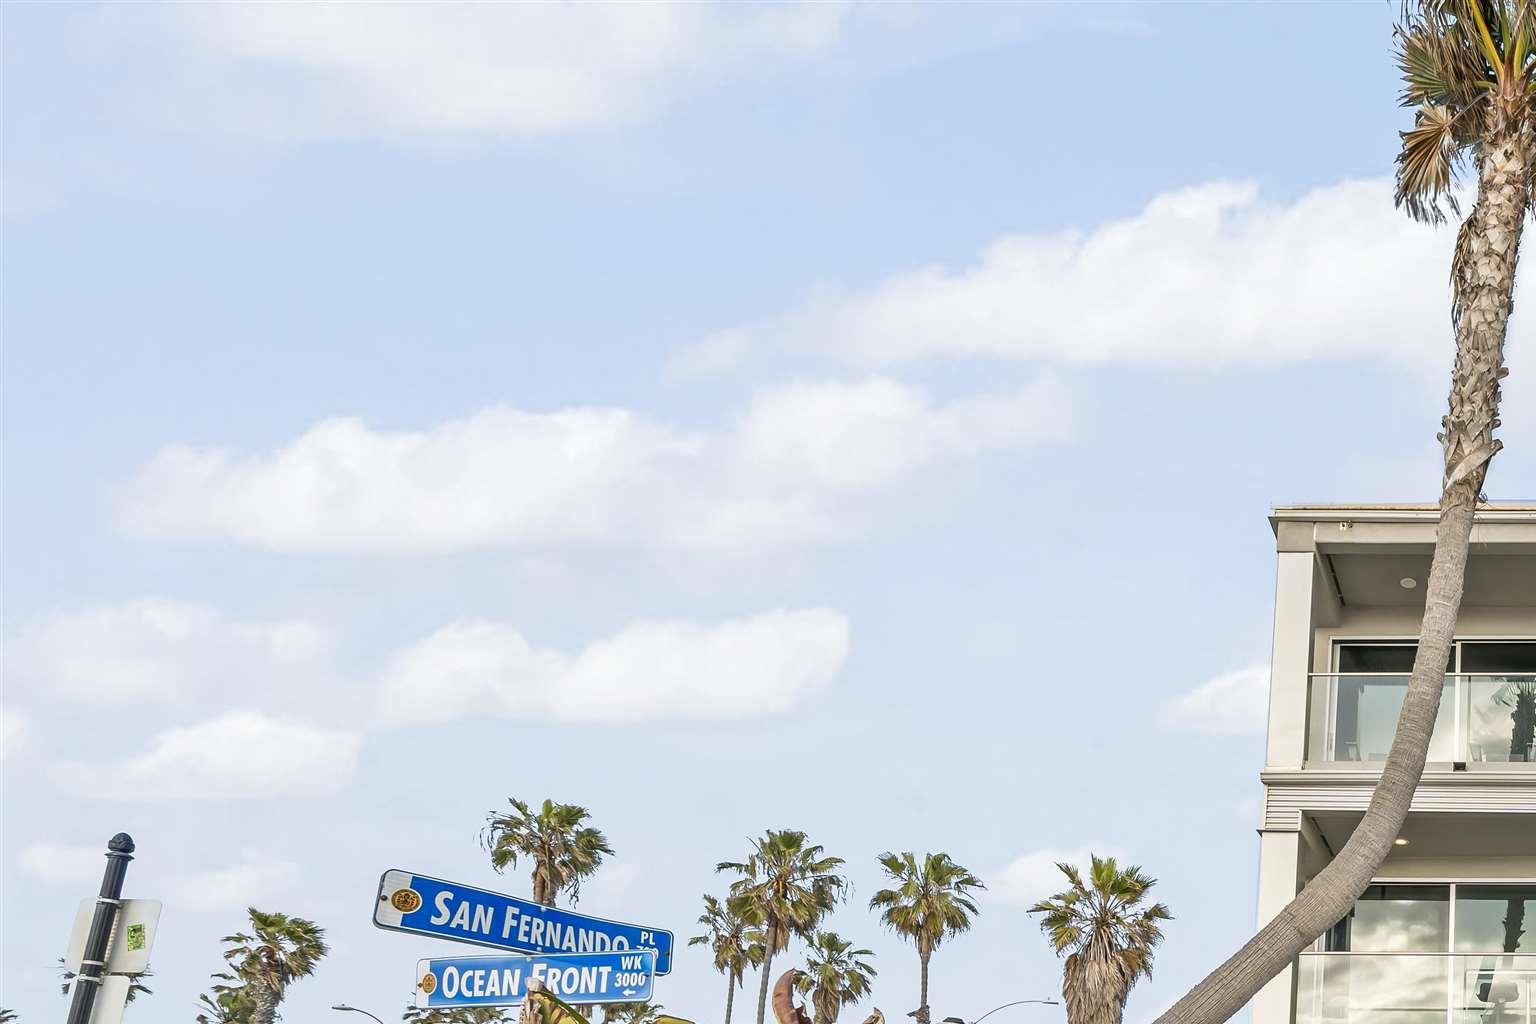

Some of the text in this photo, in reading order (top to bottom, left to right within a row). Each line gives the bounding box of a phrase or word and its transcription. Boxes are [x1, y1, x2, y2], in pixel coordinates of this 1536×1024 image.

[430, 890, 656, 952] SAN FERNANDO PL
[442, 955, 643, 998] OCEAN FRONT WK
[614, 972, 646, 987] 3000
